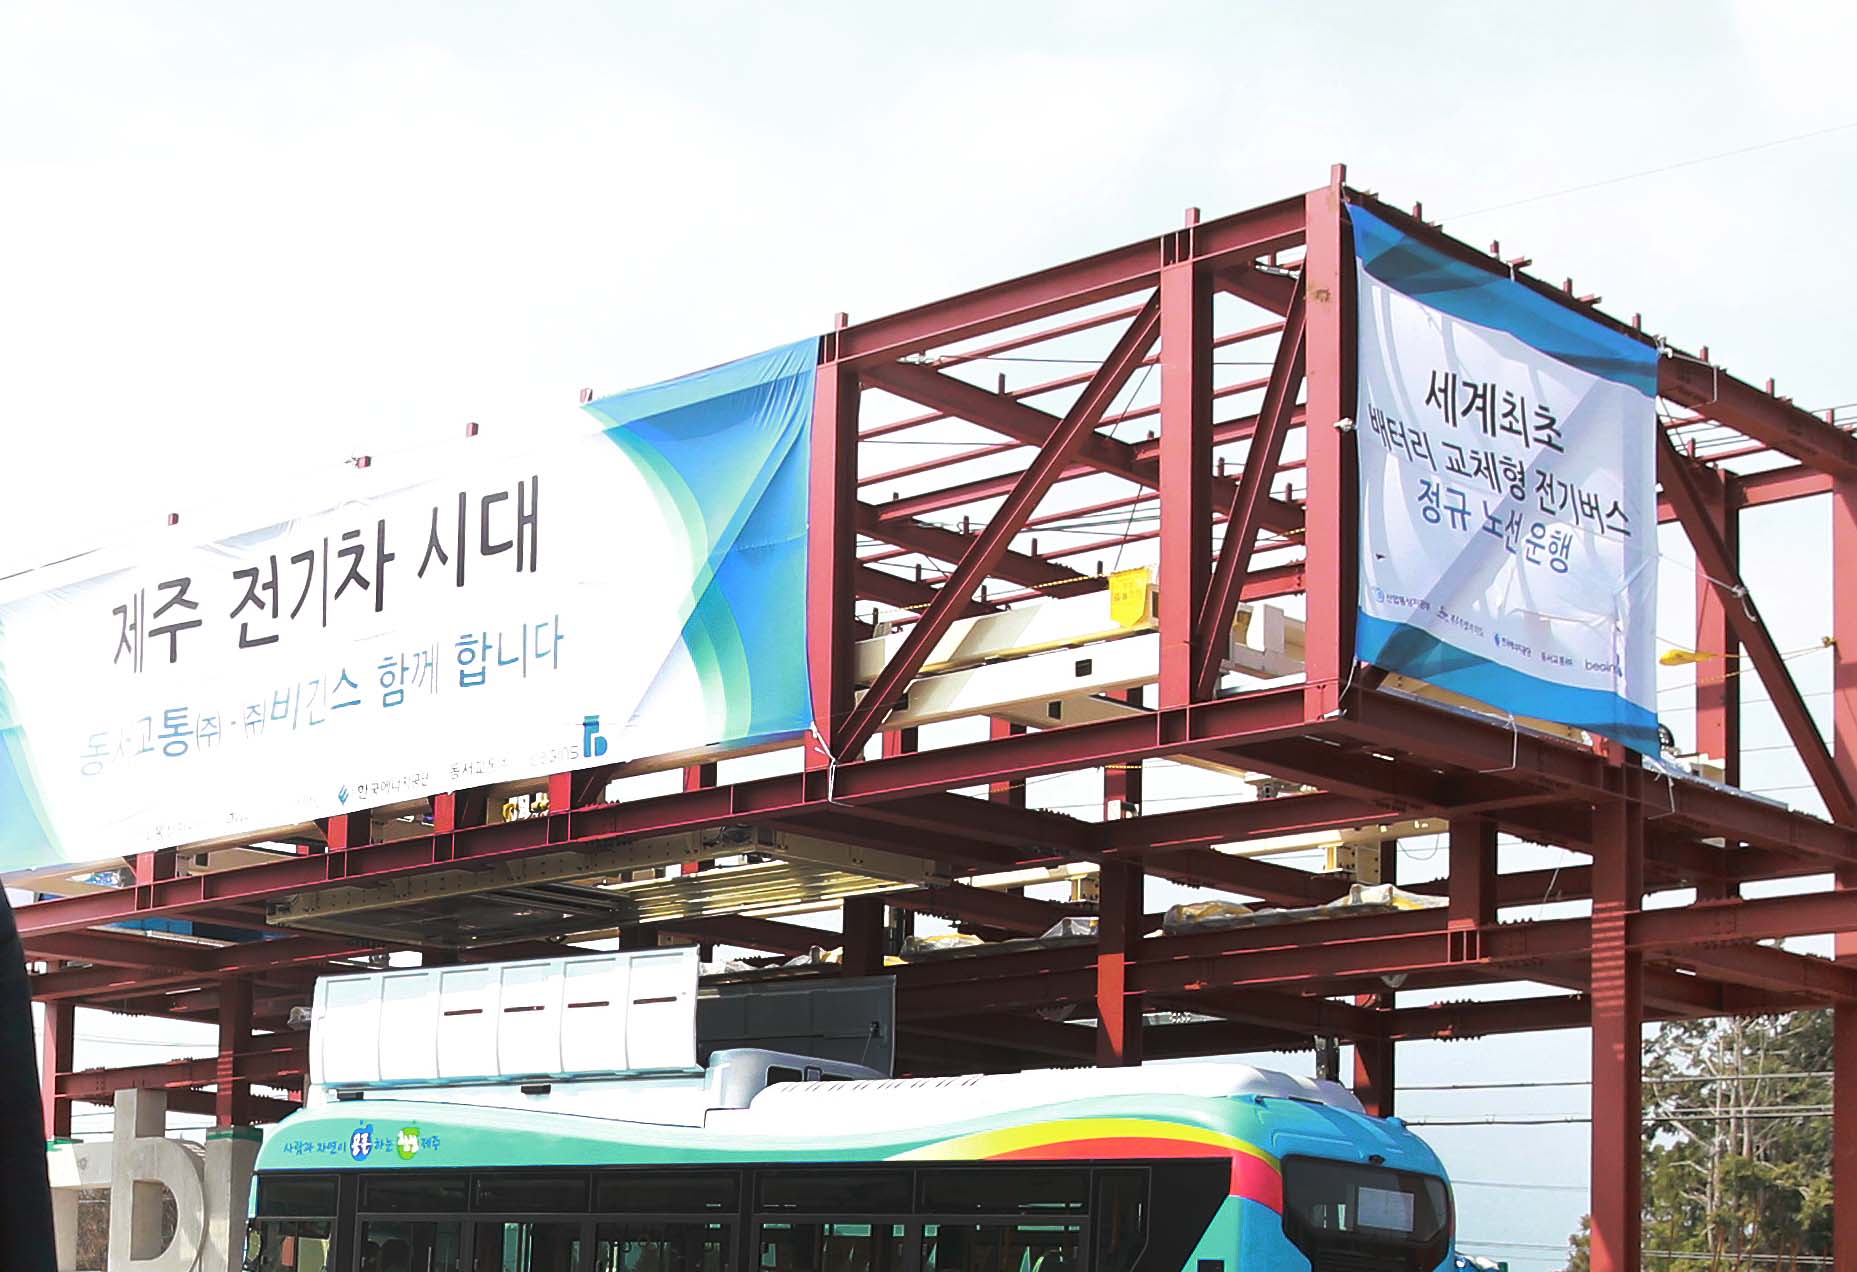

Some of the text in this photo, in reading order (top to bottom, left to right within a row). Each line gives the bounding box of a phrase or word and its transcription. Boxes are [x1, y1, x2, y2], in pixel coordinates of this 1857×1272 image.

[1425, 369, 1565, 453] 세계최초
[1369, 403, 1632, 537] 배터리 교체형 전기버스
[113, 474, 539, 674] 제주 전기차 시대
[1417, 478, 1573, 574] 정규 노선 운행
[378, 641, 439, 708] 함께
[455, 614, 564, 688] 합니다
